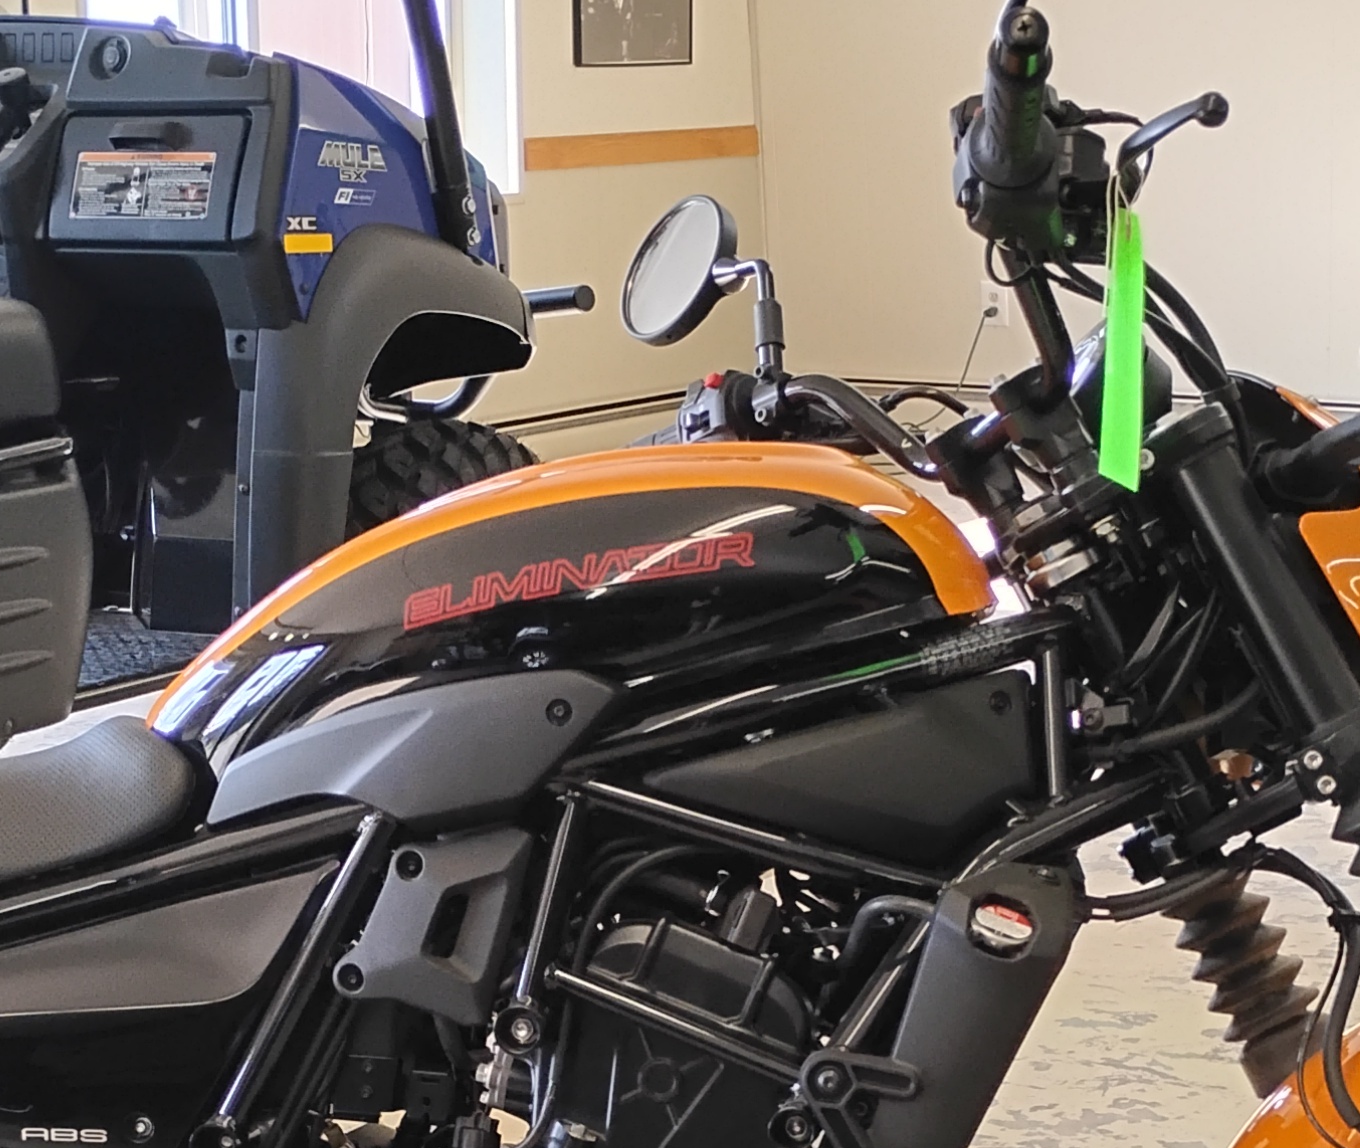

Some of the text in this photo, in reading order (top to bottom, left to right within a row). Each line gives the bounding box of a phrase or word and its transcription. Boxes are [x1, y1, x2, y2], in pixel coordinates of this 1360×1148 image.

[317, 140, 388, 172] MULE
[339, 169, 368, 183] SX
[286, 216, 317, 230] XC
[403, 532, 755, 630] ELIMINATOR
[21, 1127, 108, 1143] ABS
